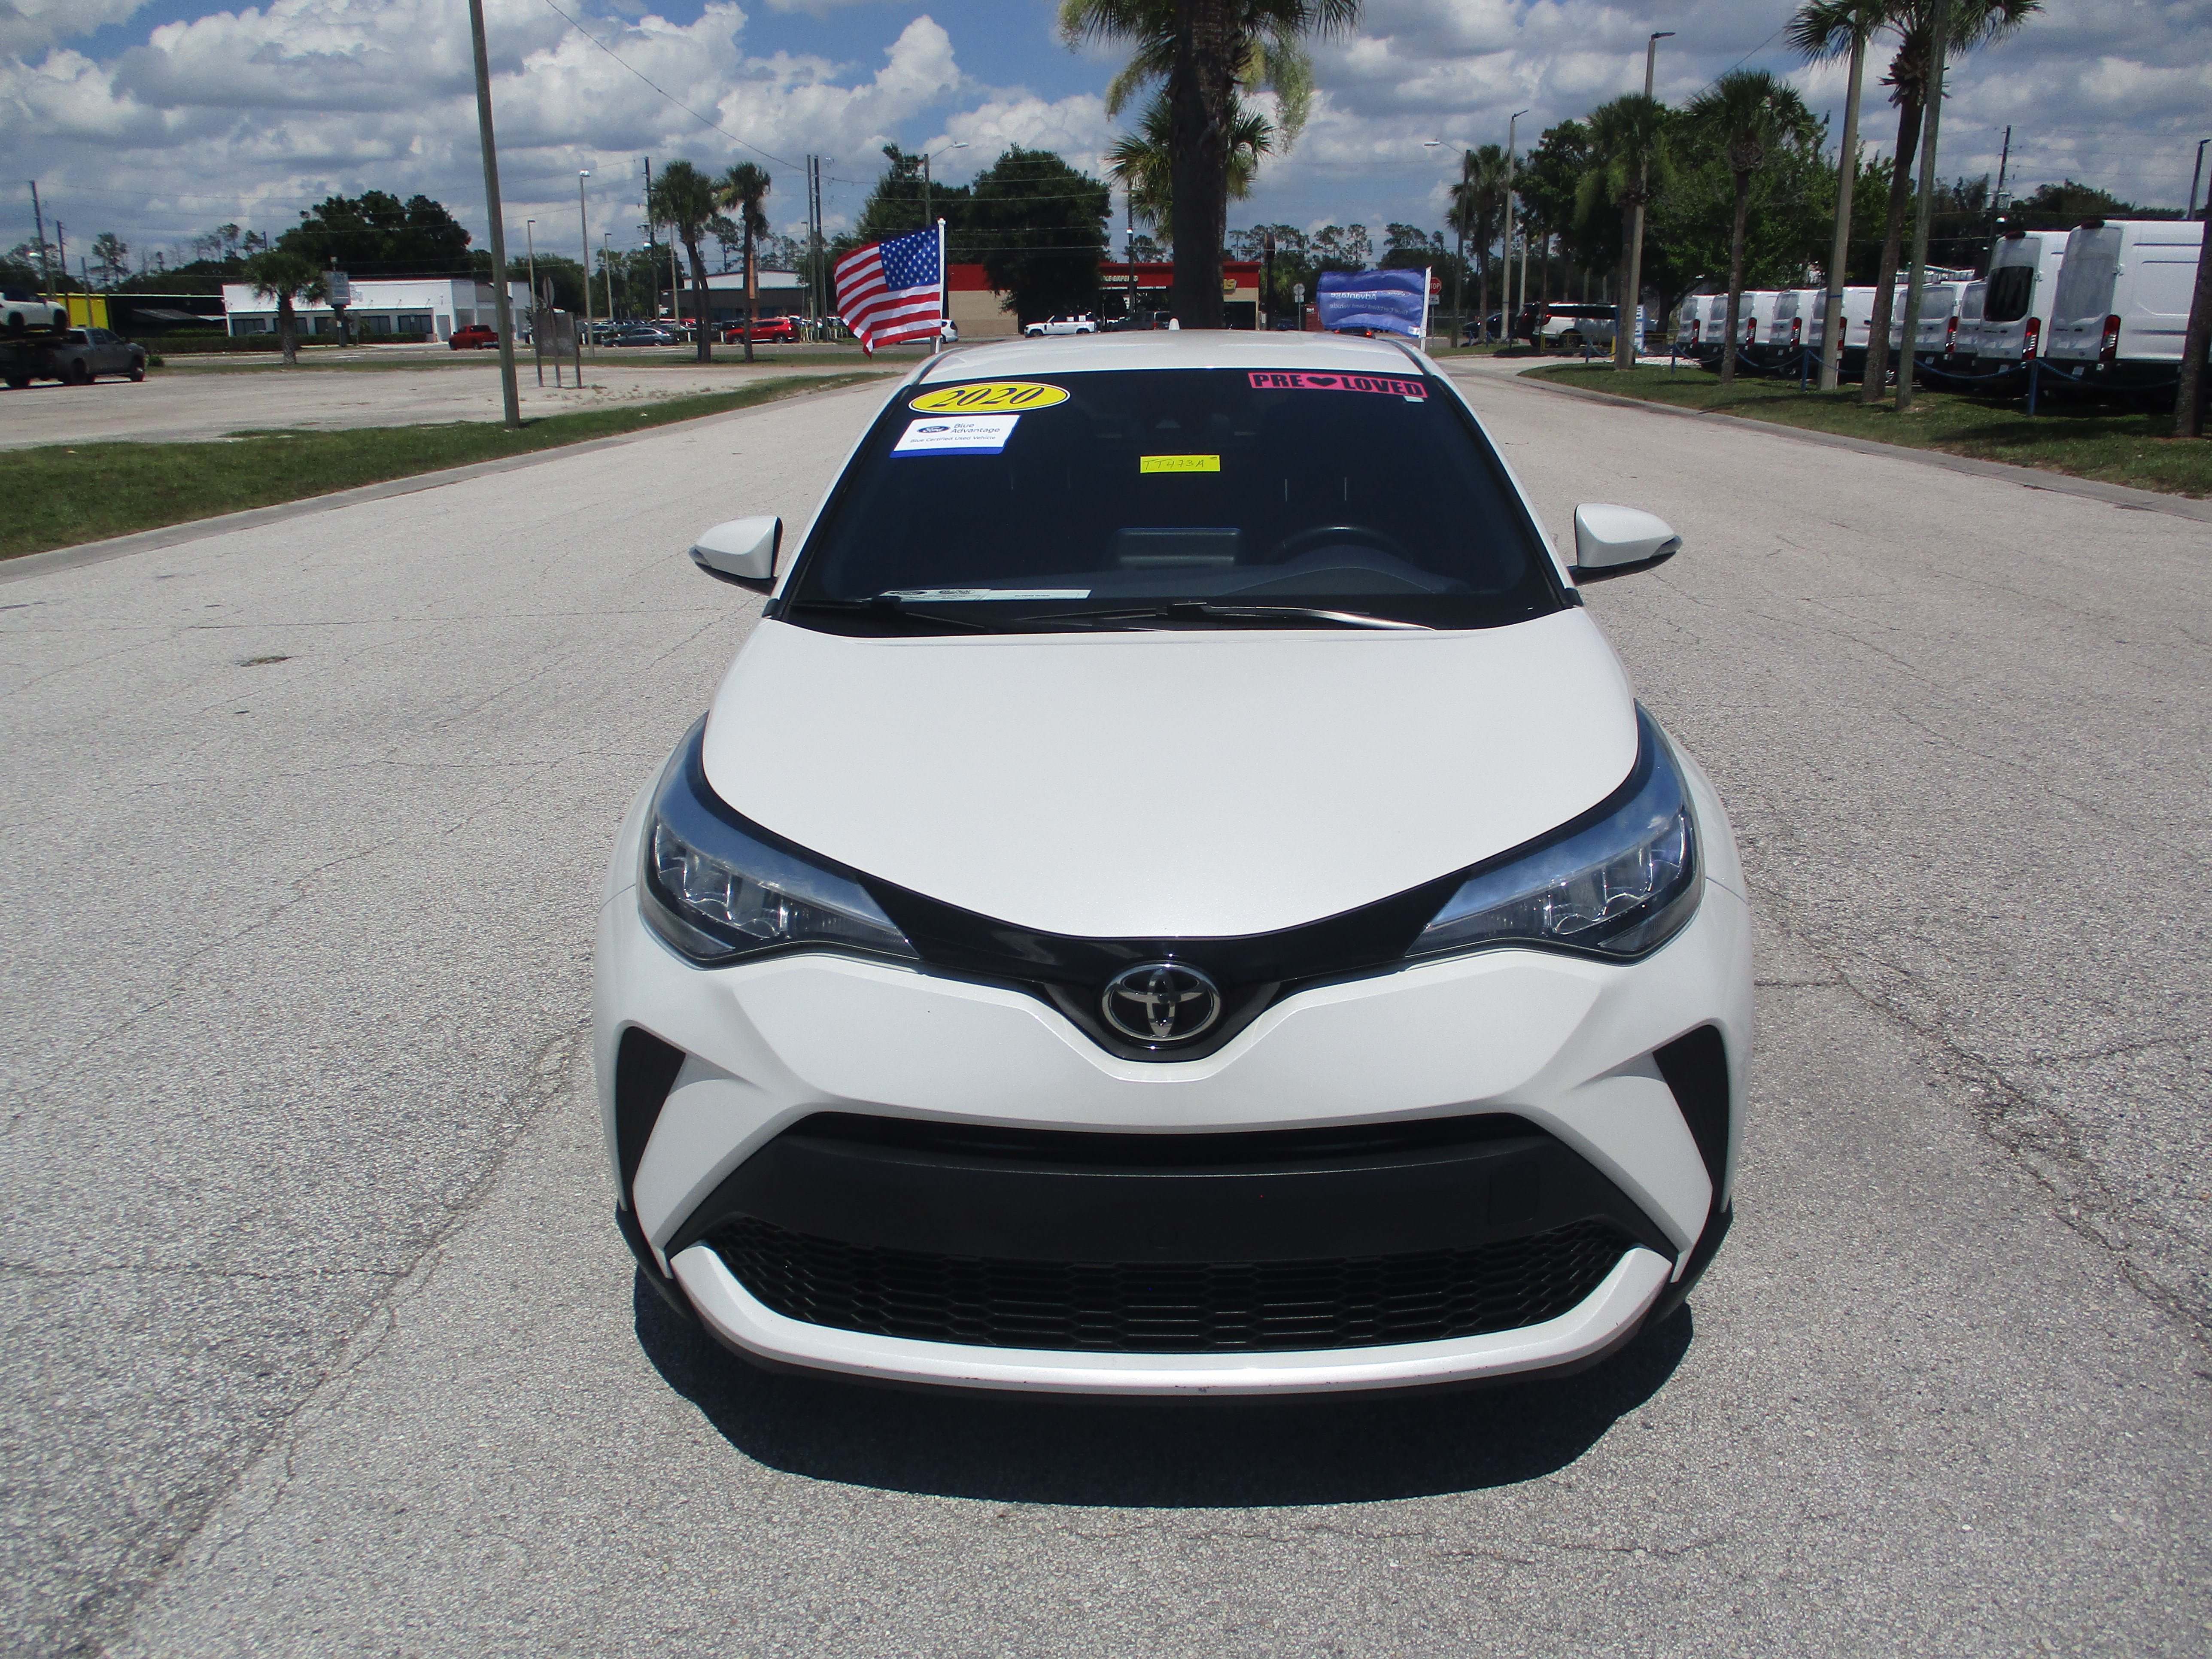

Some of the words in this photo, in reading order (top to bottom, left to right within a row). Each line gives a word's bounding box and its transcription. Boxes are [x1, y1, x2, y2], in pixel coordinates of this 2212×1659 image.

[1253, 374, 1304, 387] PRE
[1341, 377, 1423, 395] LOVED
[928, 387, 1045, 408] 2020
